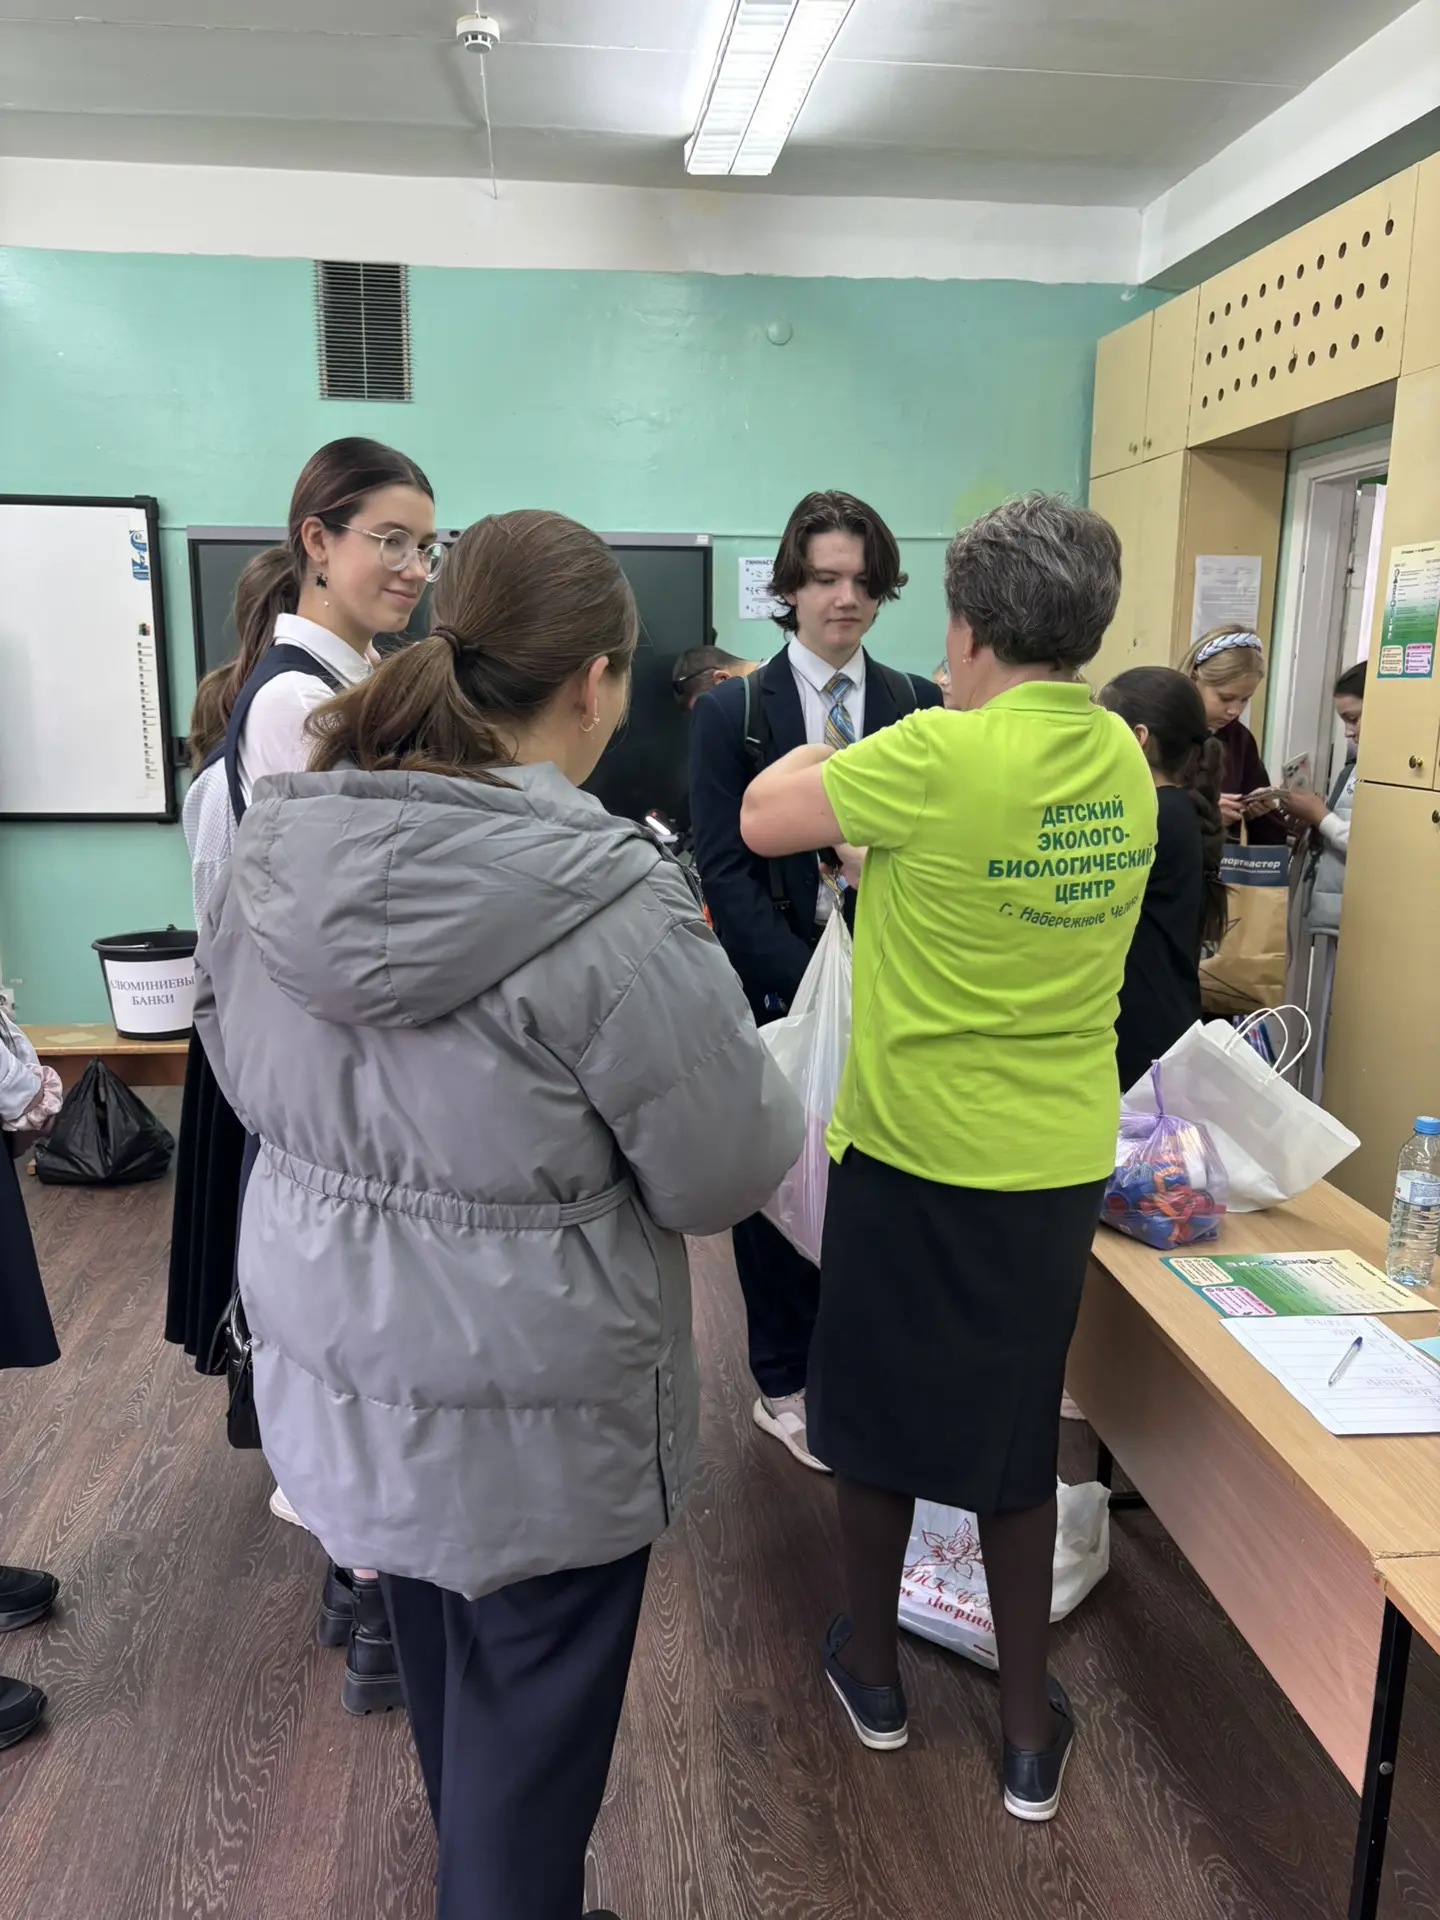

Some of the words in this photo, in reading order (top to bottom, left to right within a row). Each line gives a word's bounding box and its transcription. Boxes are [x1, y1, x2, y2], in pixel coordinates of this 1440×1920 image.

[1041, 794, 1124, 828] ДЕТСКИЙ
[1037, 826, 1130, 851] ЭКОЛОГО-
[987, 843, 1152, 878] БИОЛОГИЧЕСКИЙ
[1220, 856, 1281, 869] портмастер
[1055, 879, 1116, 904] ЦЕНТР
[1020, 906, 1106, 929] Набережные
[110, 975, 195, 992] ЛЮМИНИЕВЫ
[132, 994, 175, 1006] БАНКИ
